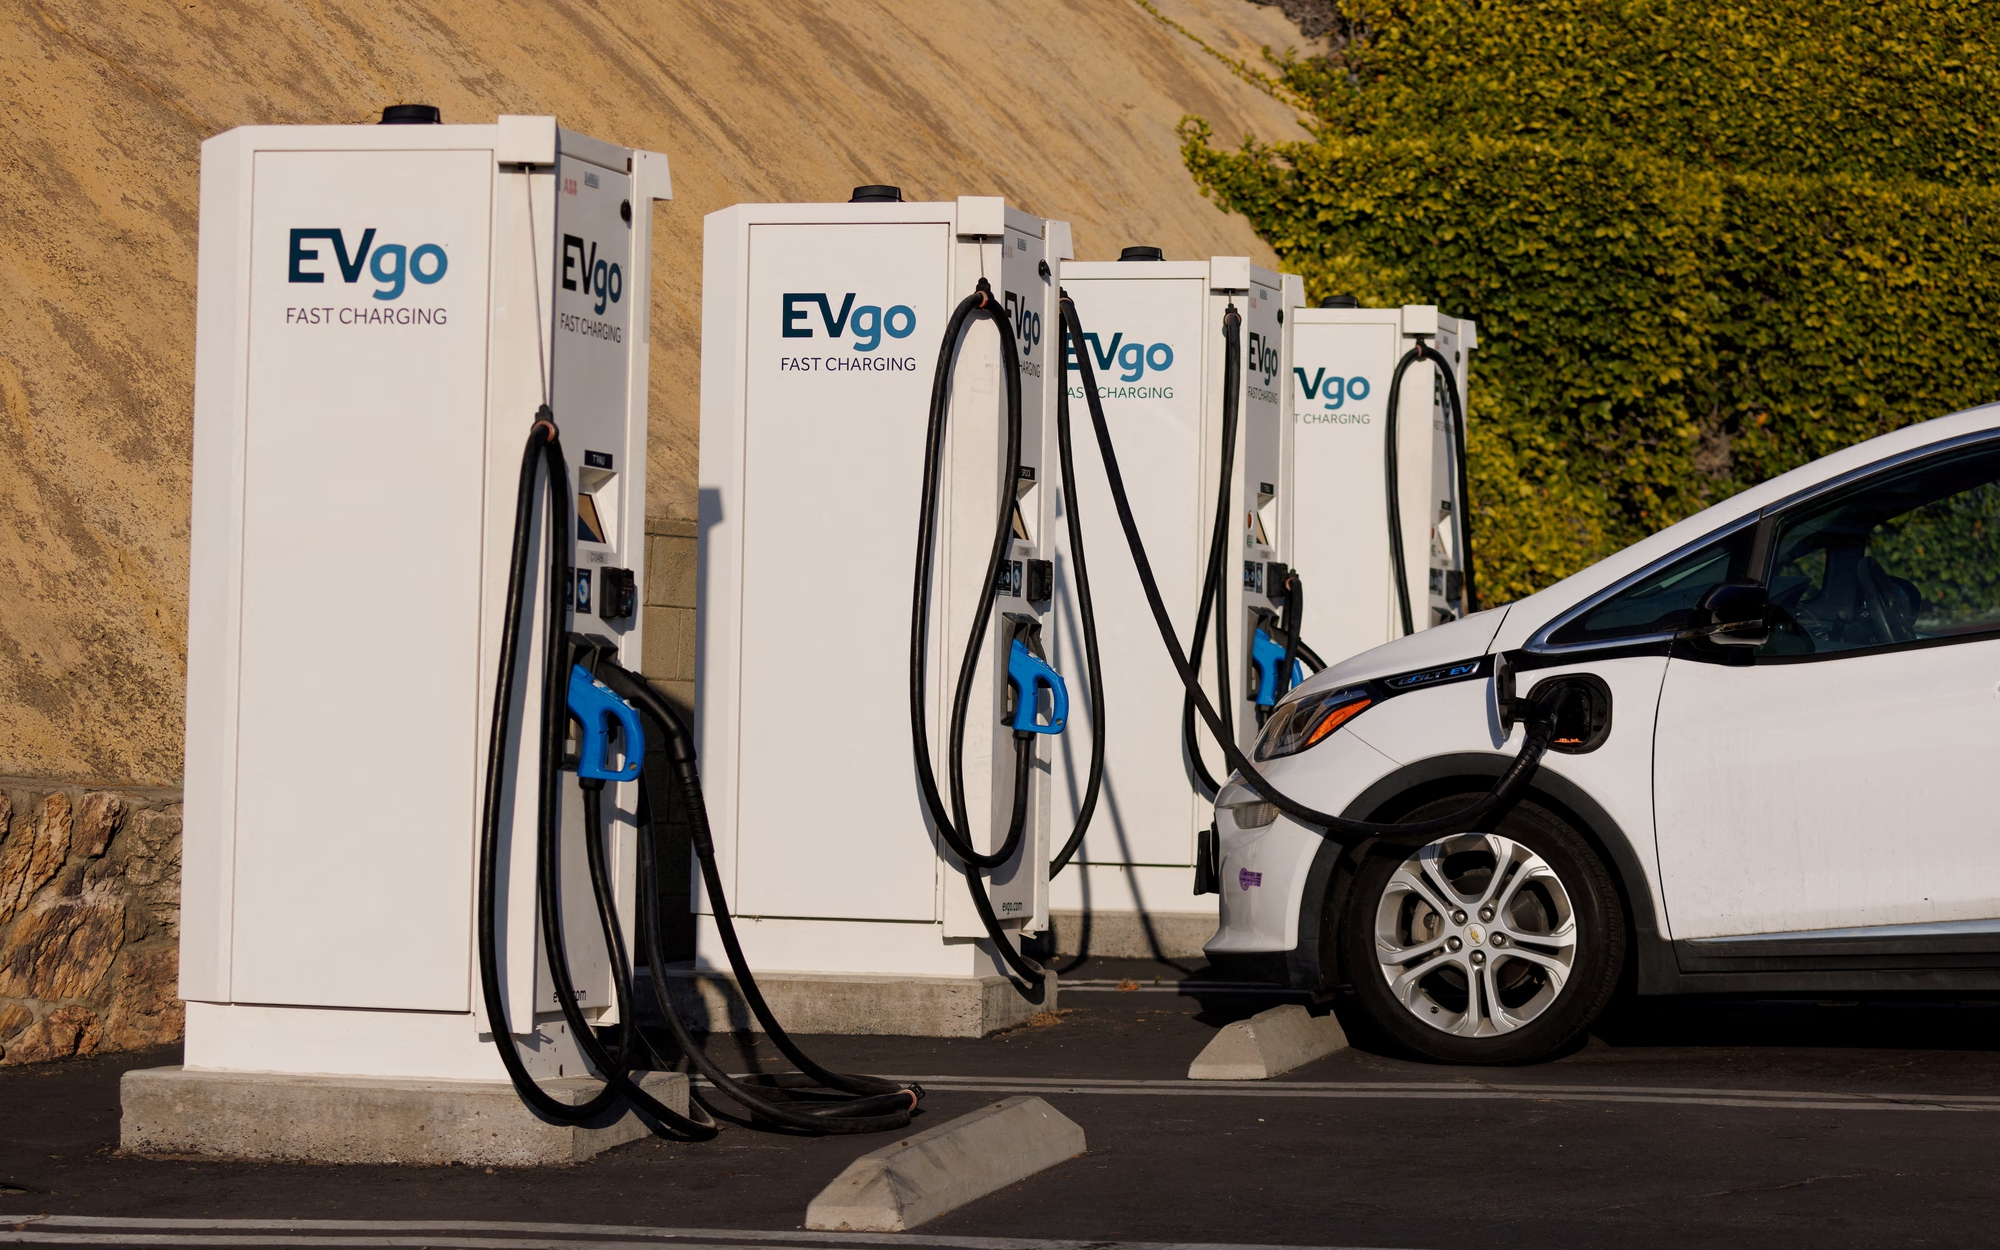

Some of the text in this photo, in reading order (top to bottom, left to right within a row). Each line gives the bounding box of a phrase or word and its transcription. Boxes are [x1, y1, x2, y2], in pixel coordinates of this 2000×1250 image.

[288, 228, 448, 301] EVgo
[562, 233, 622, 316] EVgo
[286, 307, 447, 325] FAST CHARGING
[560, 313, 622, 344] FAST CHARGING
[782, 292, 917, 352] EVgo
[781, 357, 916, 371] FAST CHARGING
[1249, 331, 1279, 387] EVgo
[1067, 386, 1174, 399] AS CHARGING
[1293, 367, 1370, 410] Vgo
[1303, 413, 1371, 425] CHARGING
[1398, 664, 1473, 686] BOLT EV
